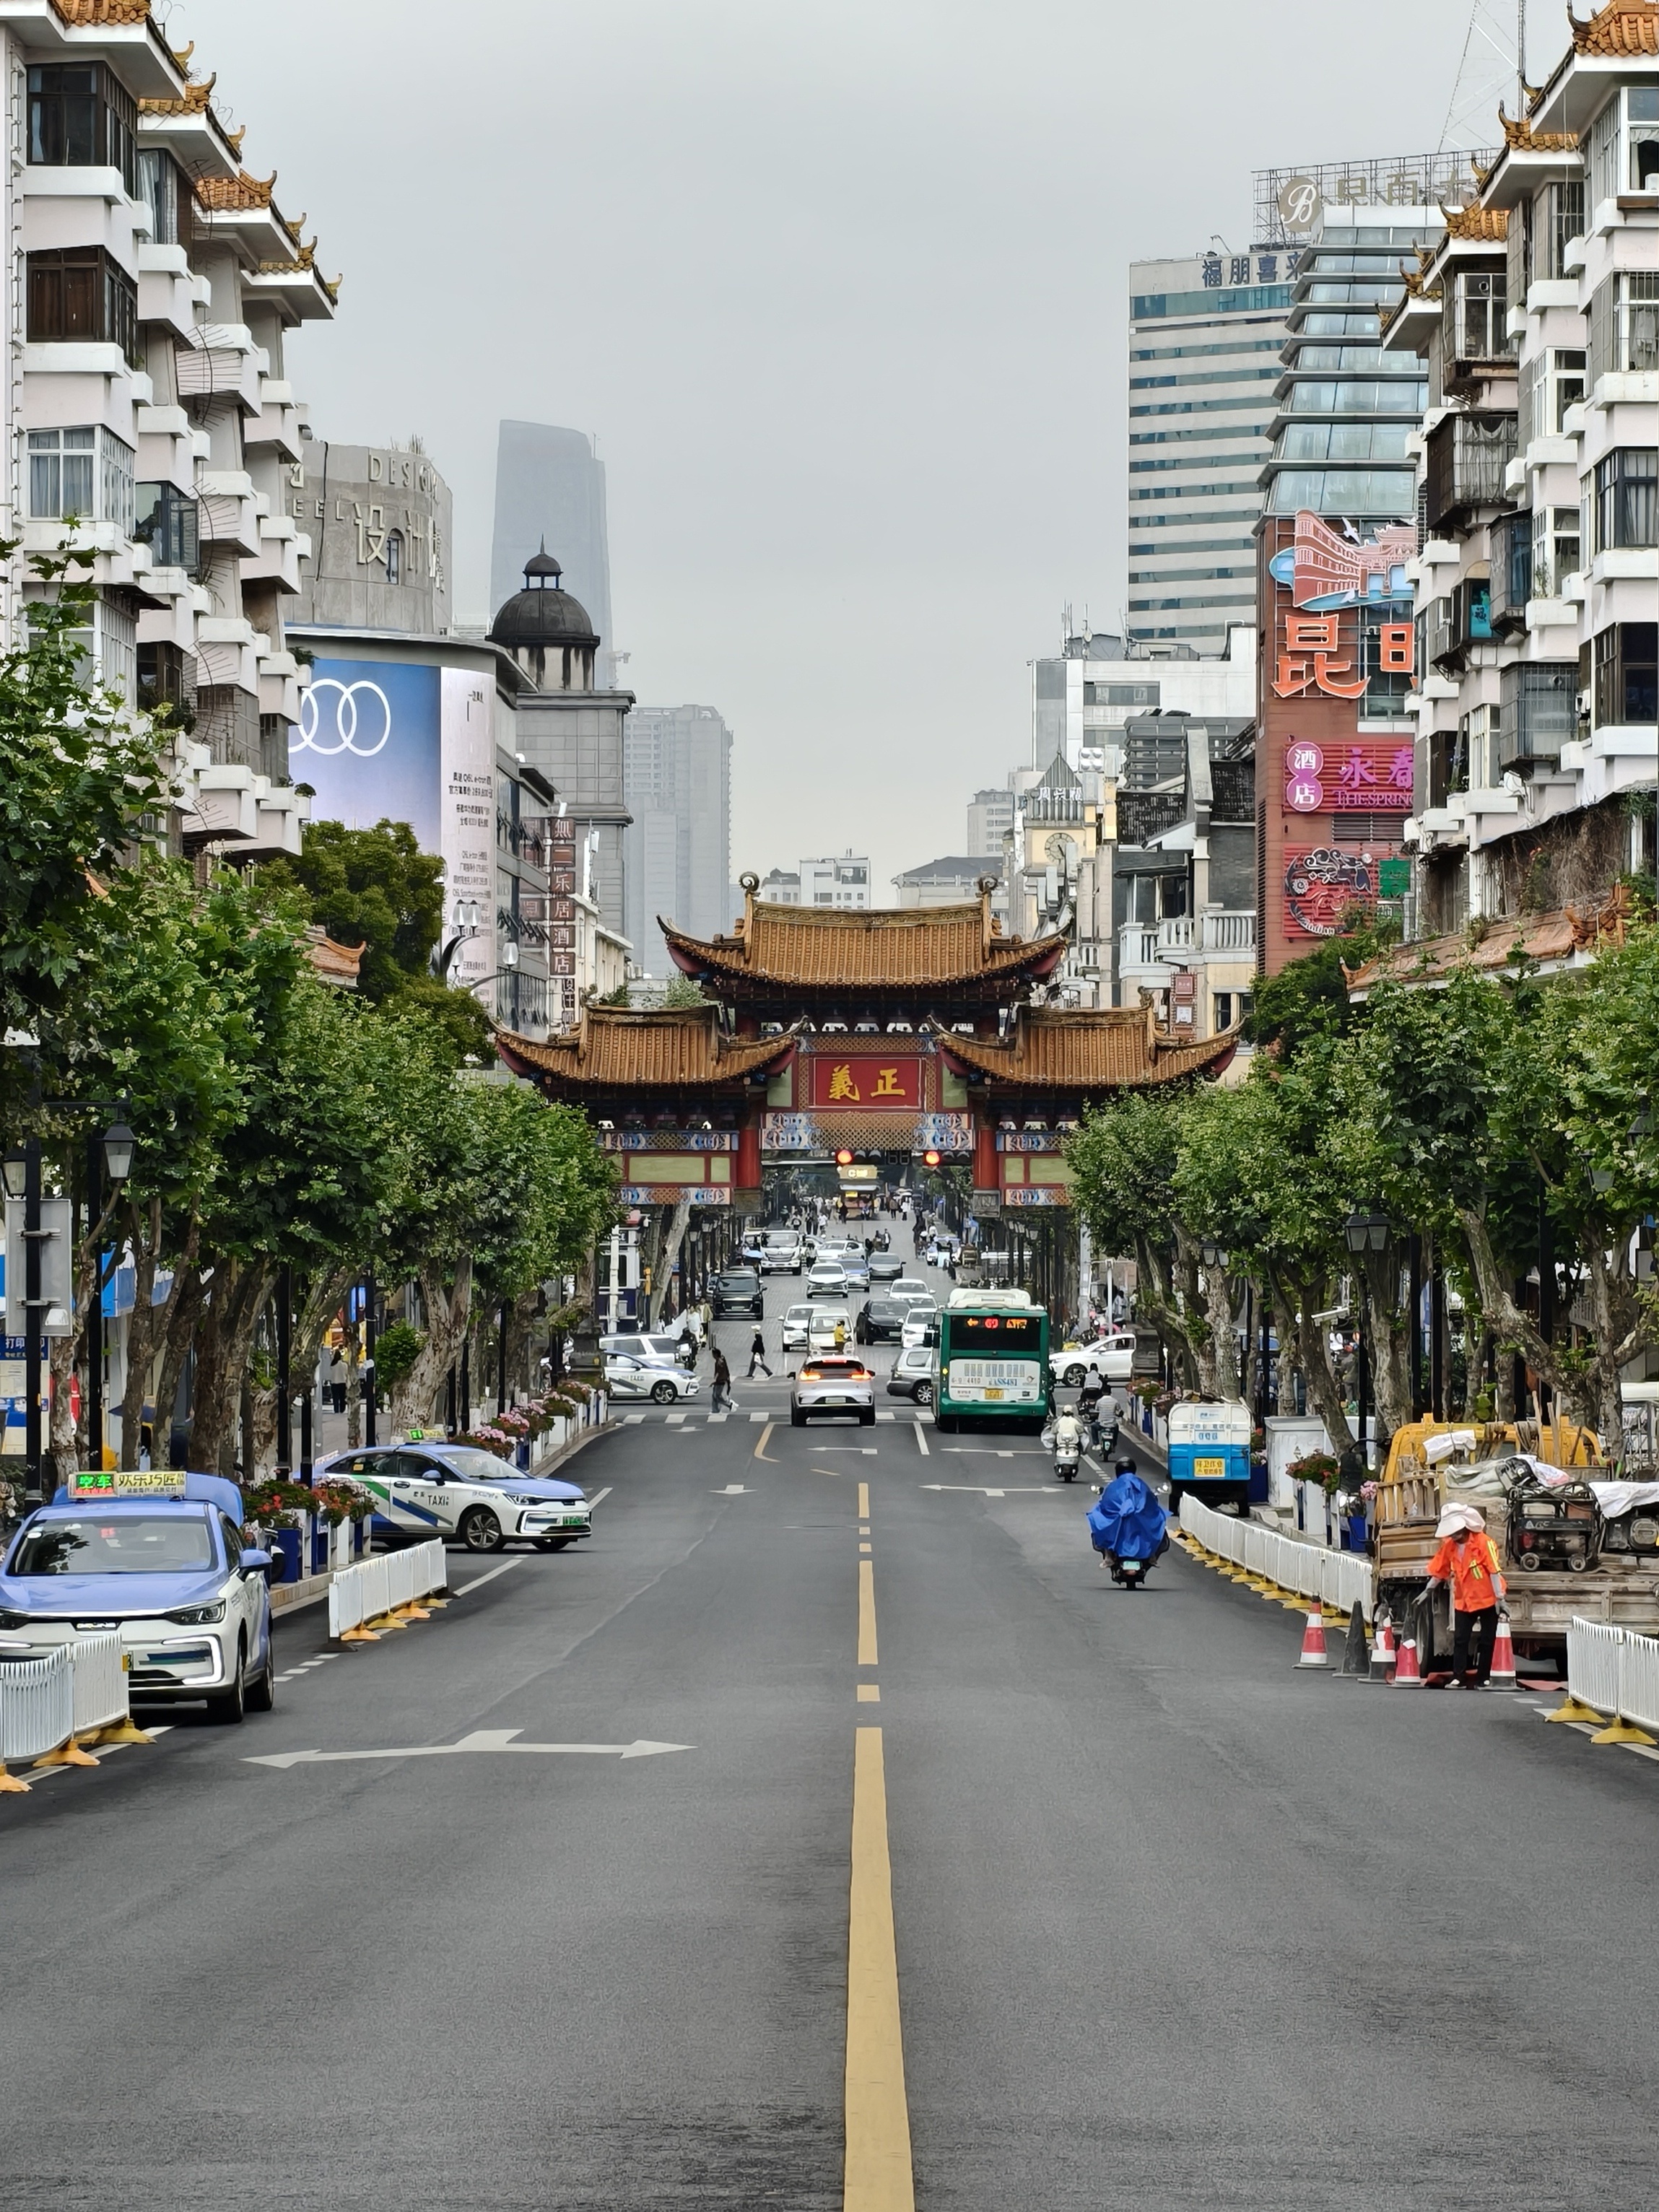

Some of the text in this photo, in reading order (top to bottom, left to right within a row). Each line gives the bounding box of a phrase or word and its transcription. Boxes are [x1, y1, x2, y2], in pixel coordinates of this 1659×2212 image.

[1294, 749, 1318, 804] 酒店
[79, 1476, 112, 1489] 空车
[118, 1474, 176, 1486] 欢乐巧匠
